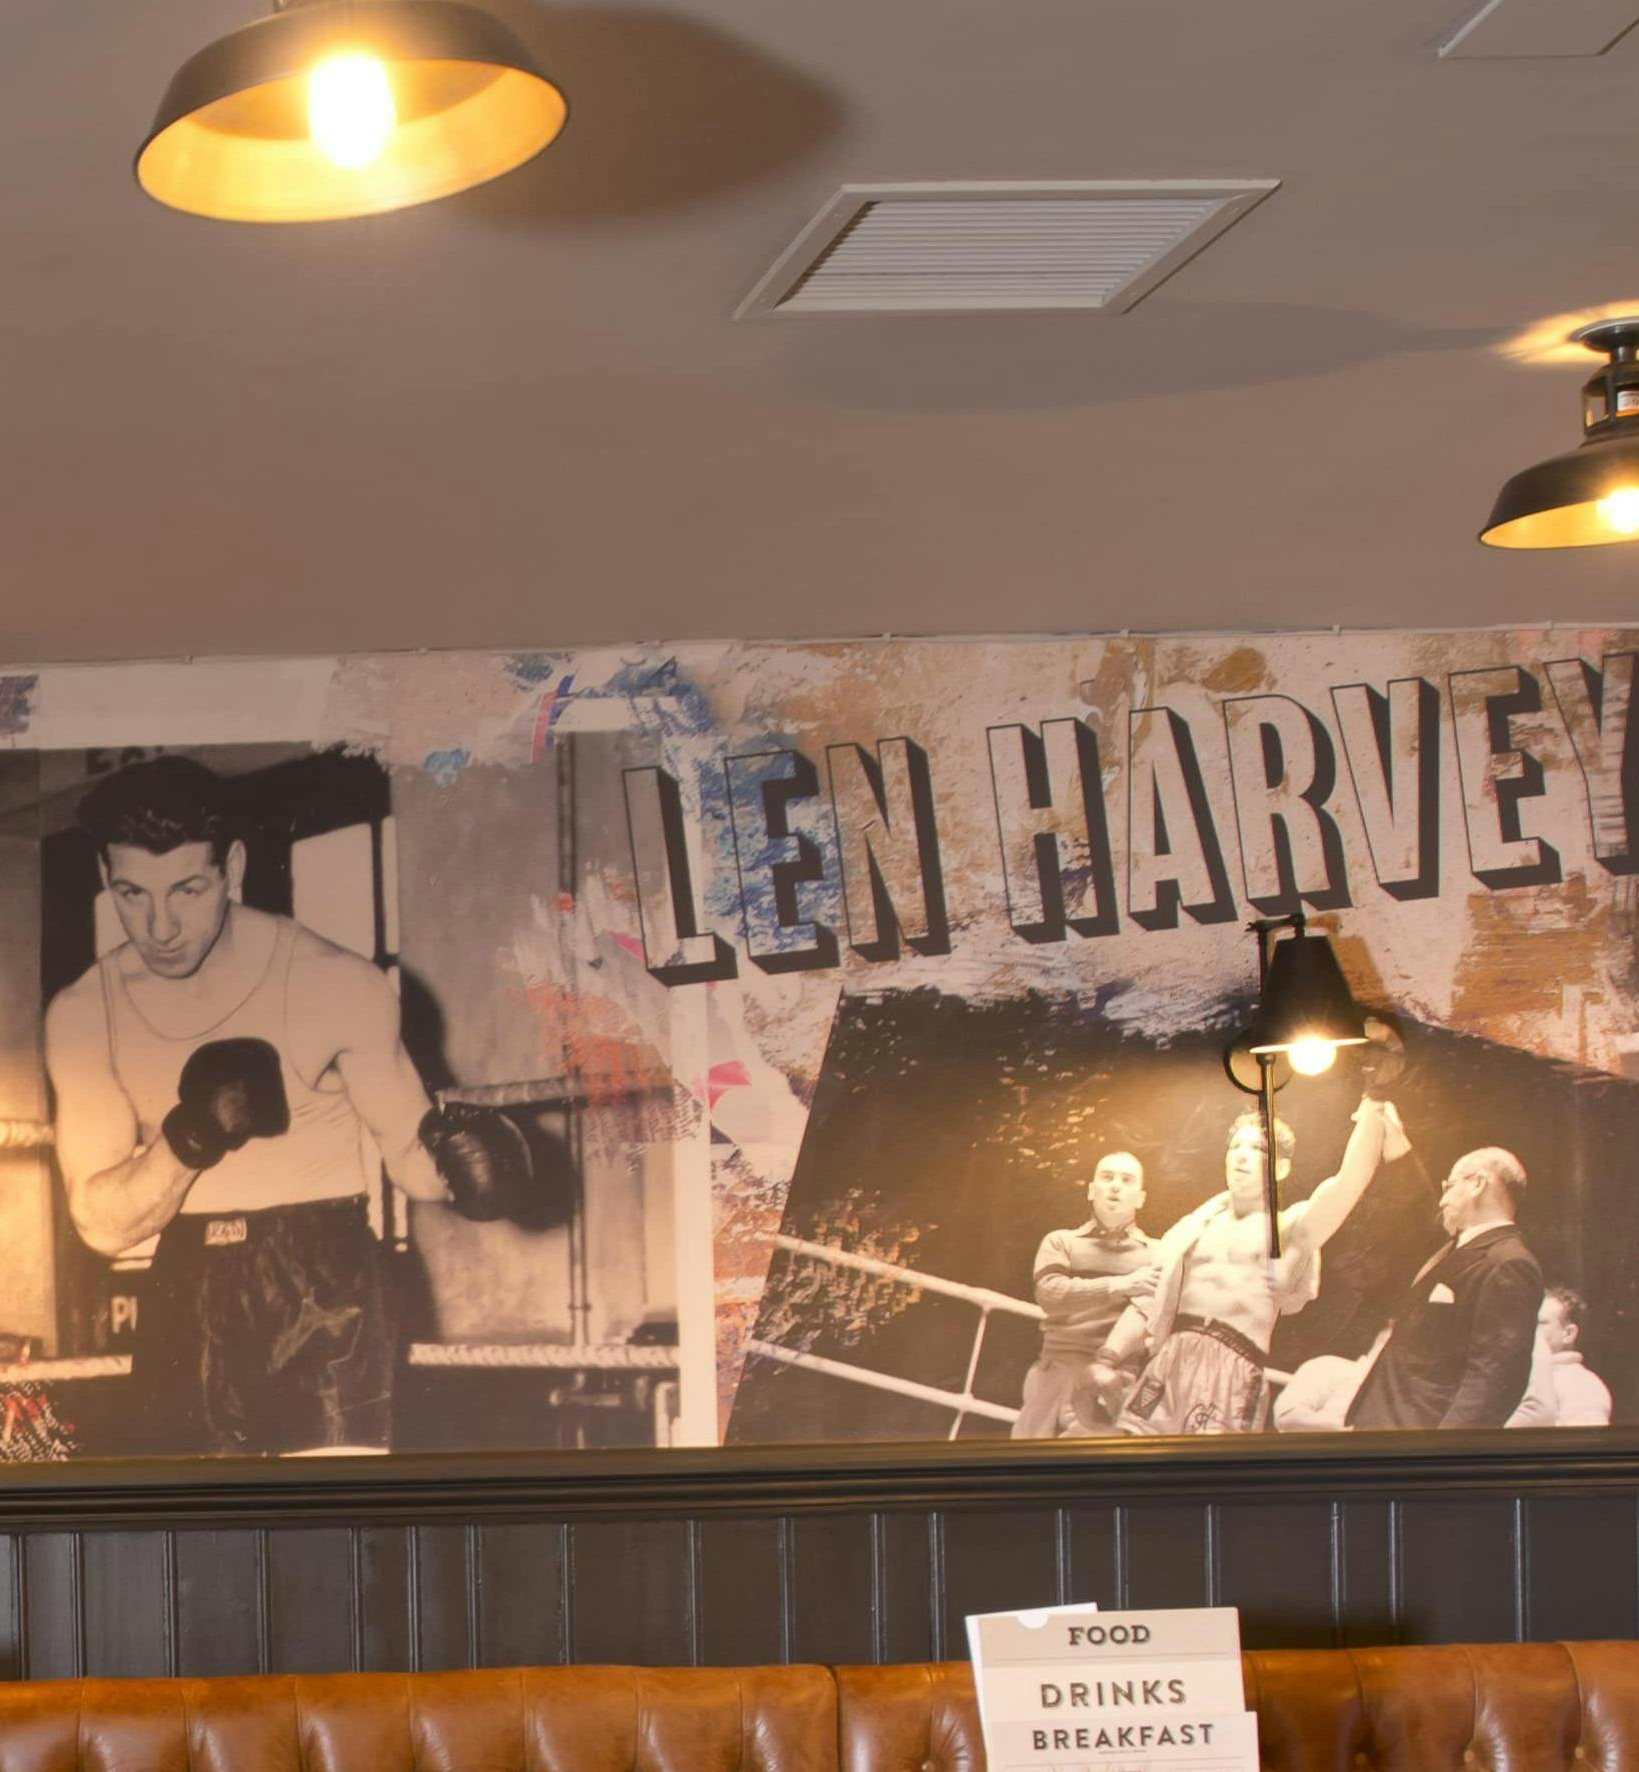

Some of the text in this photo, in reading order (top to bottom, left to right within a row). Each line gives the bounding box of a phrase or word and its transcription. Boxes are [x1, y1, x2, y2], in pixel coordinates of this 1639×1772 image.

[622, 736, 951, 987] LEN
[1068, 1624, 1151, 1646] FOOD
[1040, 1678, 1187, 1709] DRINKS
[1032, 1723, 1214, 1751] BREAKFAST
